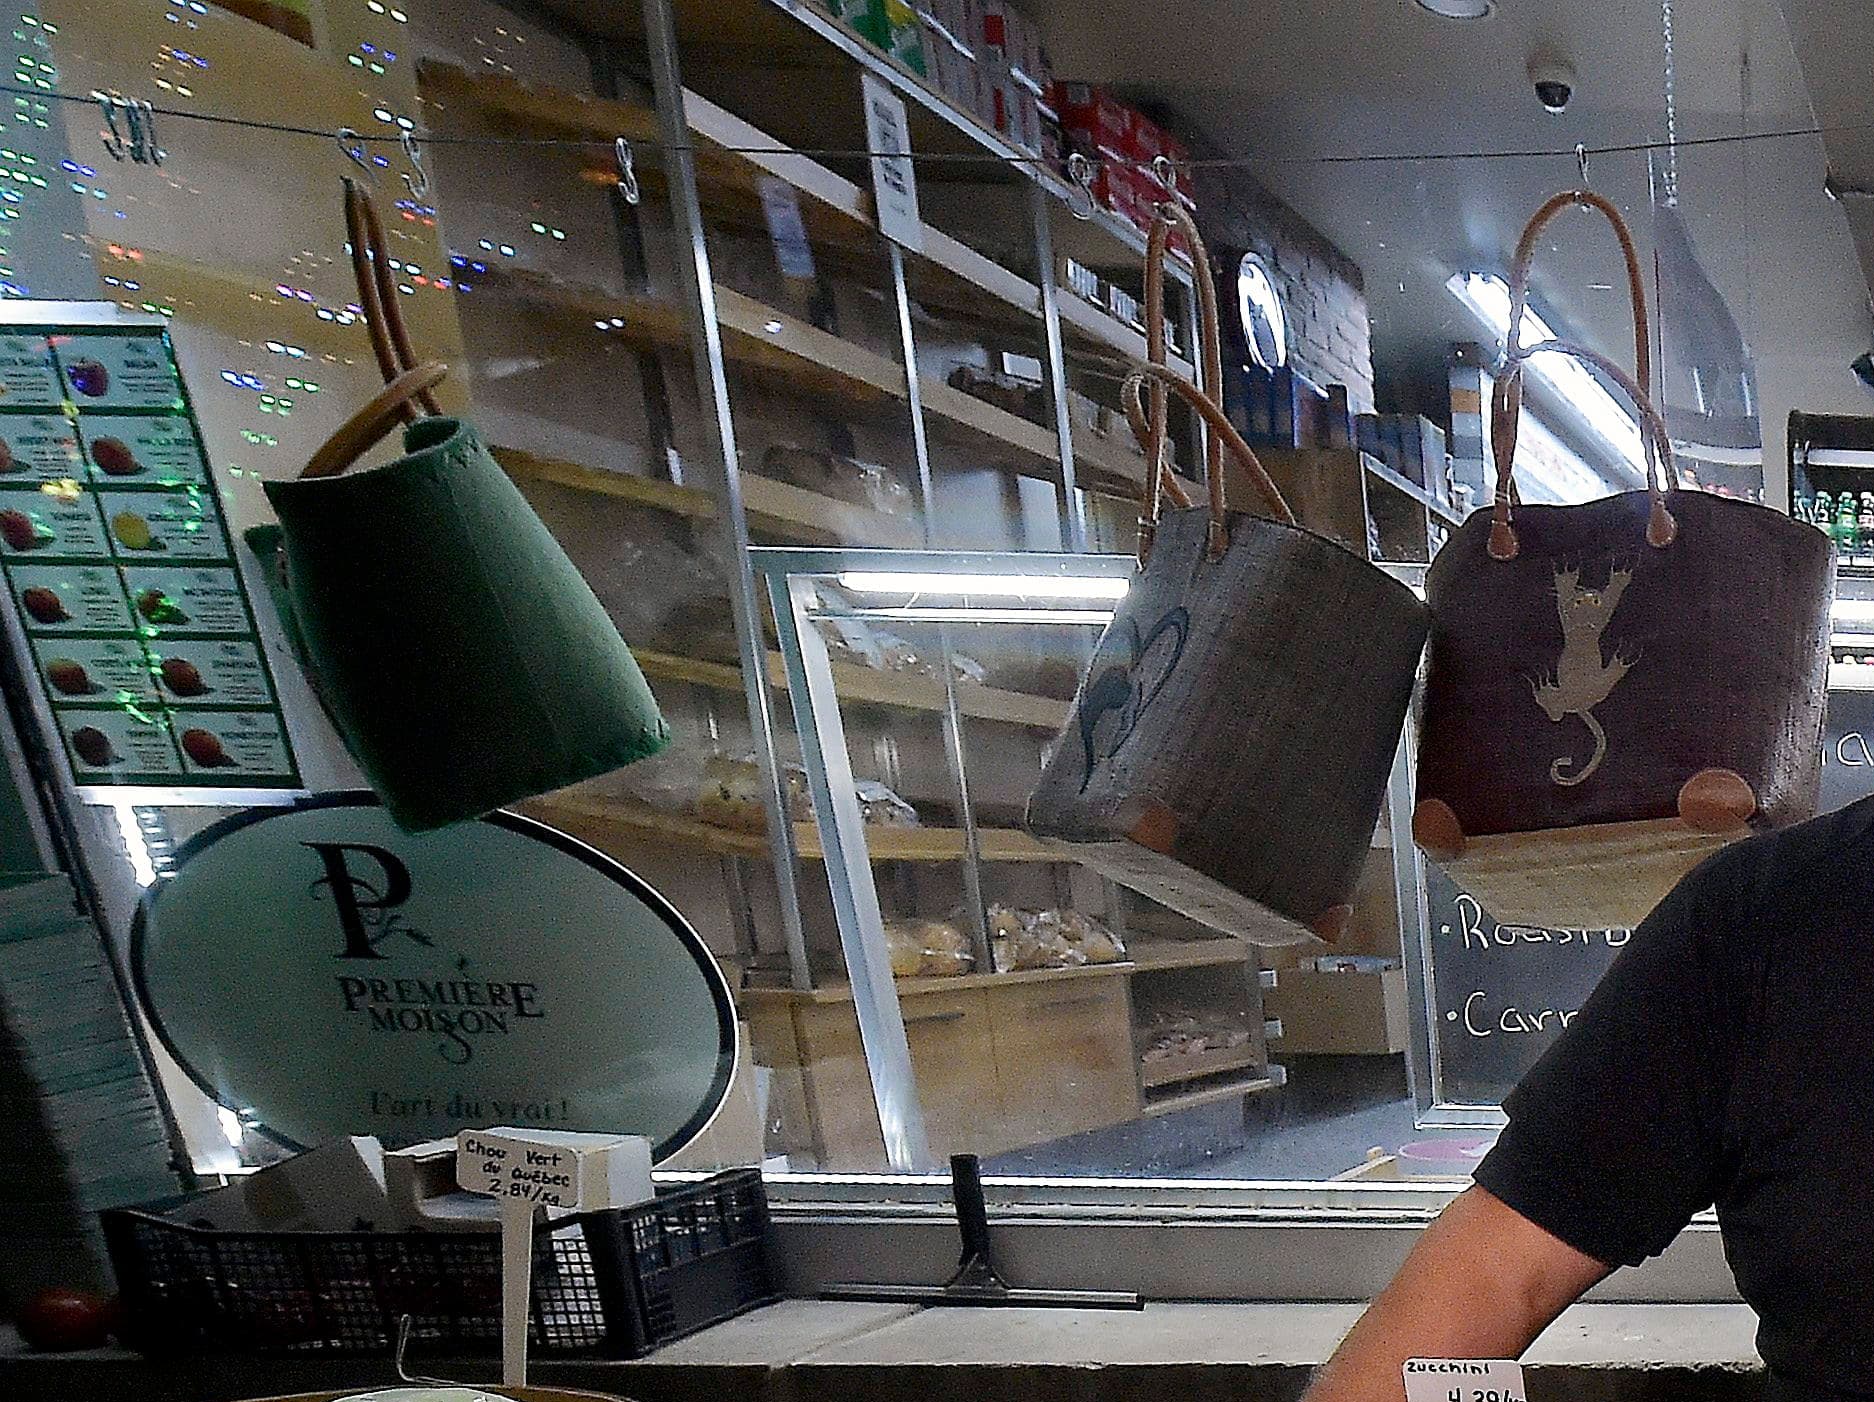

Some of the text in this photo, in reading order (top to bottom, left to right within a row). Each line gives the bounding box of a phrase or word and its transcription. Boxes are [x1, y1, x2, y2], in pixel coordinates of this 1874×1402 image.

[1465, 992, 1579, 1037] Carr
[367, 1008, 508, 1056] MOISON
[482, 1161, 500, 1174] du
[526, 1150, 563, 1167] Vert
